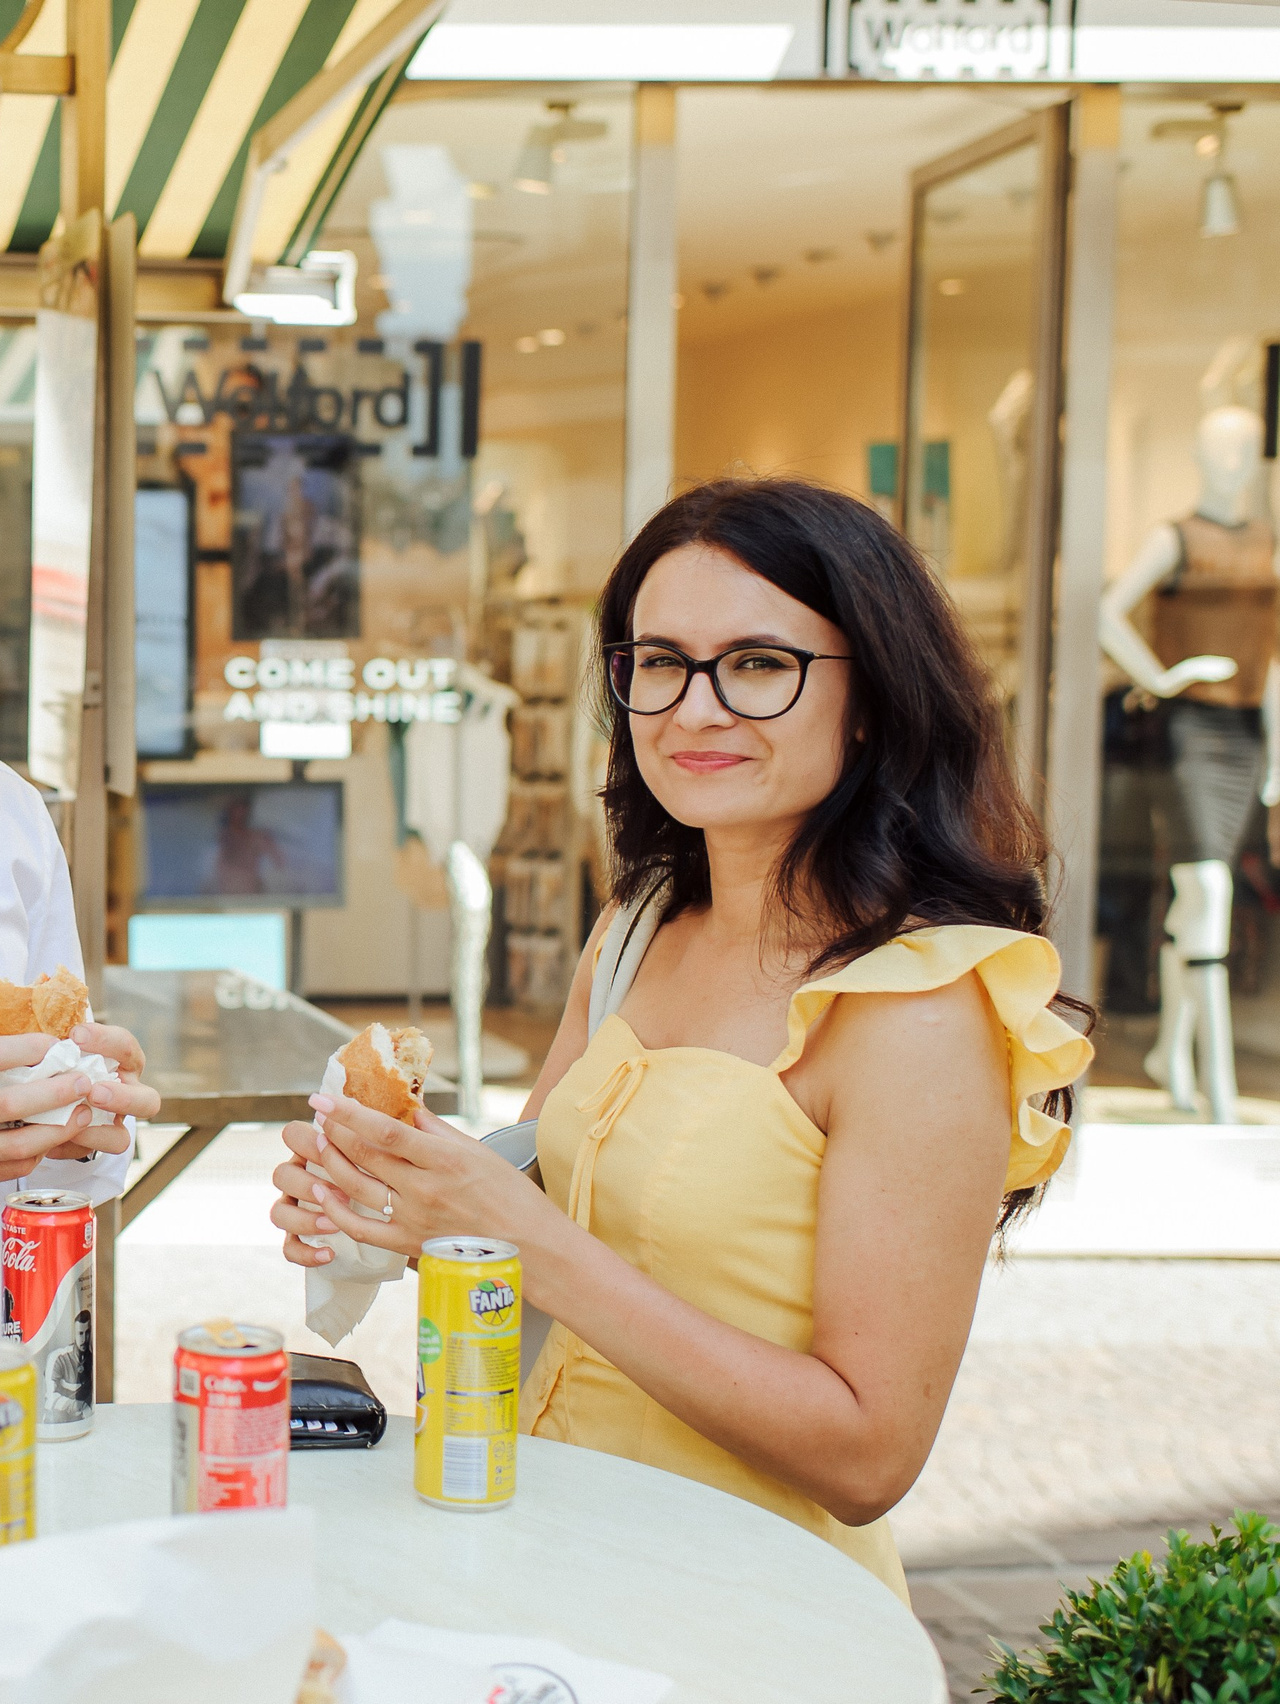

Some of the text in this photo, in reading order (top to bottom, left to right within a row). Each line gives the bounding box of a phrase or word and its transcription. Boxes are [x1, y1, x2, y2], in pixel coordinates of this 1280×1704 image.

[223, 656, 458, 690] COME OUT
[222, 691, 462, 724] AND SHINE
[6, 1225, 26, 1235] TASTE
[469, 1285, 515, 1313] FANTA
